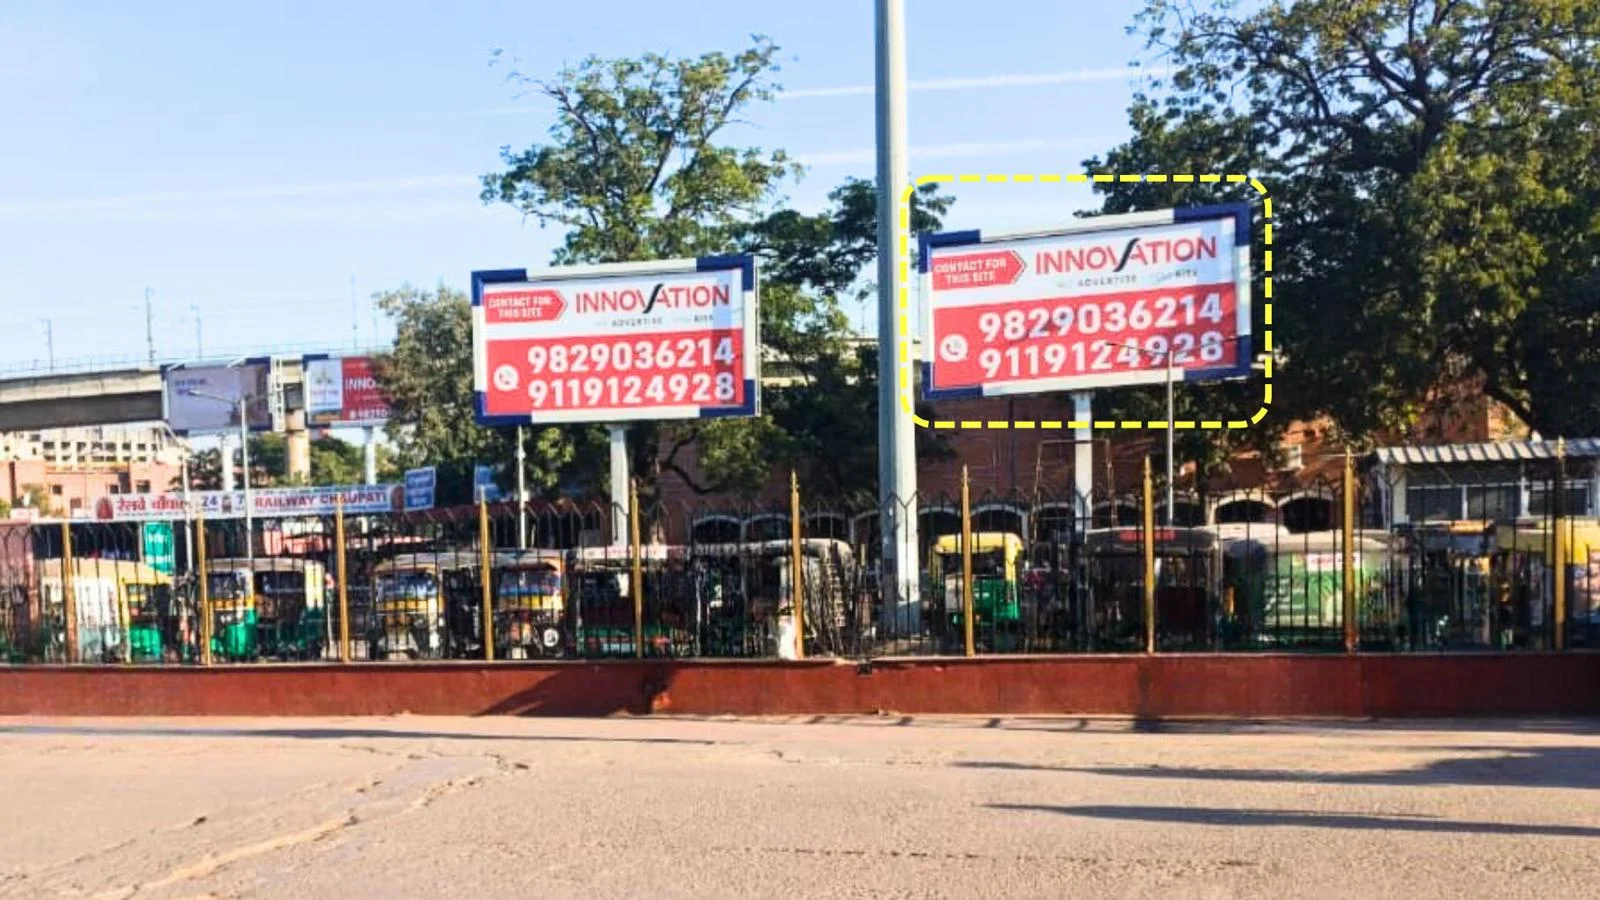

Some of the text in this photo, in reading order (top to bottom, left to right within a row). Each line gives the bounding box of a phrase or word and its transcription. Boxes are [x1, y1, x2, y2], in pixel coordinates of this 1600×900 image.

[934, 257, 1007, 273] CONTACT FOR
[1036, 236, 1217, 275] INNOVATION
[946, 271, 995, 284] THIS SITE
[488, 295, 552, 308] CONTACT FOR
[576, 284, 730, 314] INNOVATION
[499, 307, 542, 318] THIS SITE
[978, 293, 1223, 342] 9829036214
[527, 337, 736, 374] 9829036214
[979, 331, 1225, 378] 9119124928
[527, 372, 735, 407] 9119124928
[202, 495, 218, 506] 24
[255, 494, 315, 508] RAILWAY
